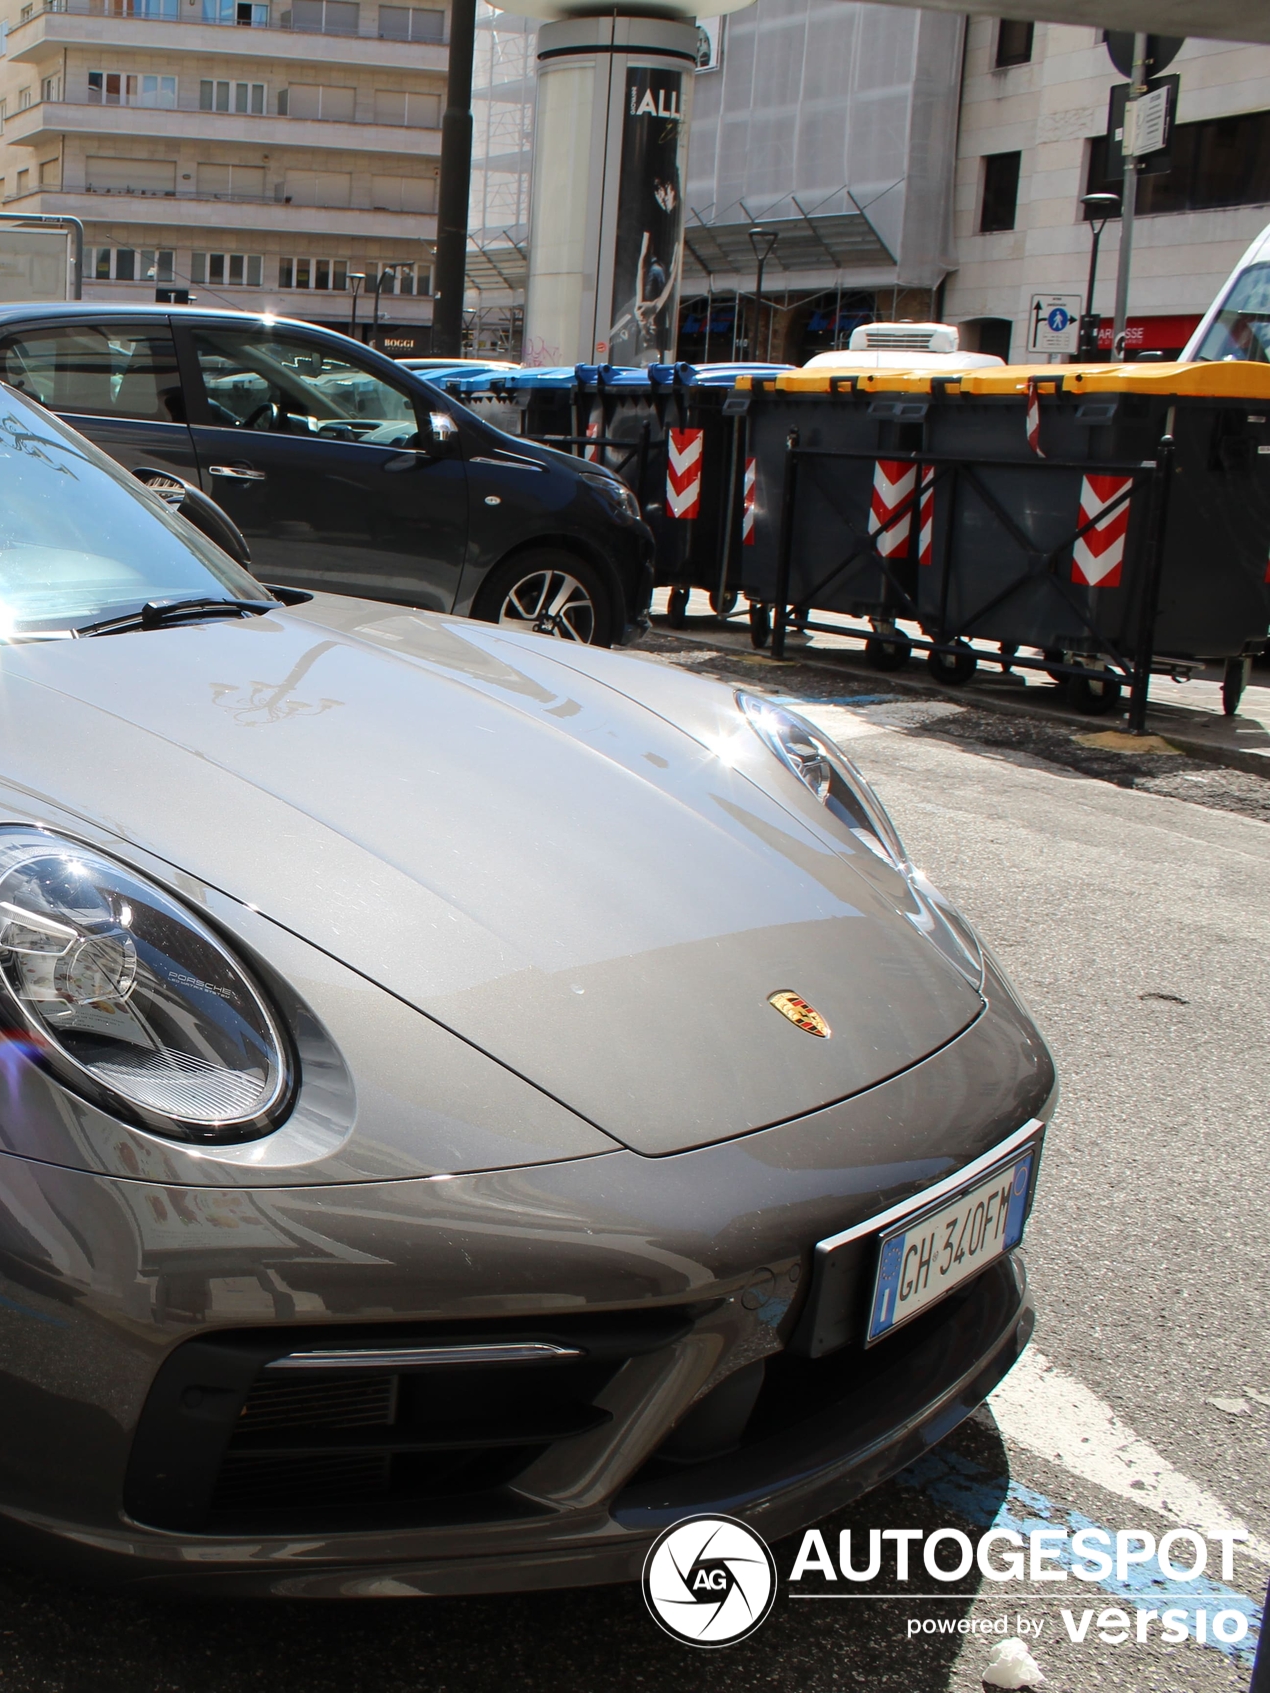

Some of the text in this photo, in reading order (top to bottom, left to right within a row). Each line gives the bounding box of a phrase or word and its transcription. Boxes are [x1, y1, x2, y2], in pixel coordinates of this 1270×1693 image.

[384, 338, 414, 348] BOGGI
[168, 971, 232, 996] PORSCHE
[180, 981, 204, 991] MATRIX
[204, 988, 231, 999] SYSTEM
[899, 1232, 935, 1302] GH
